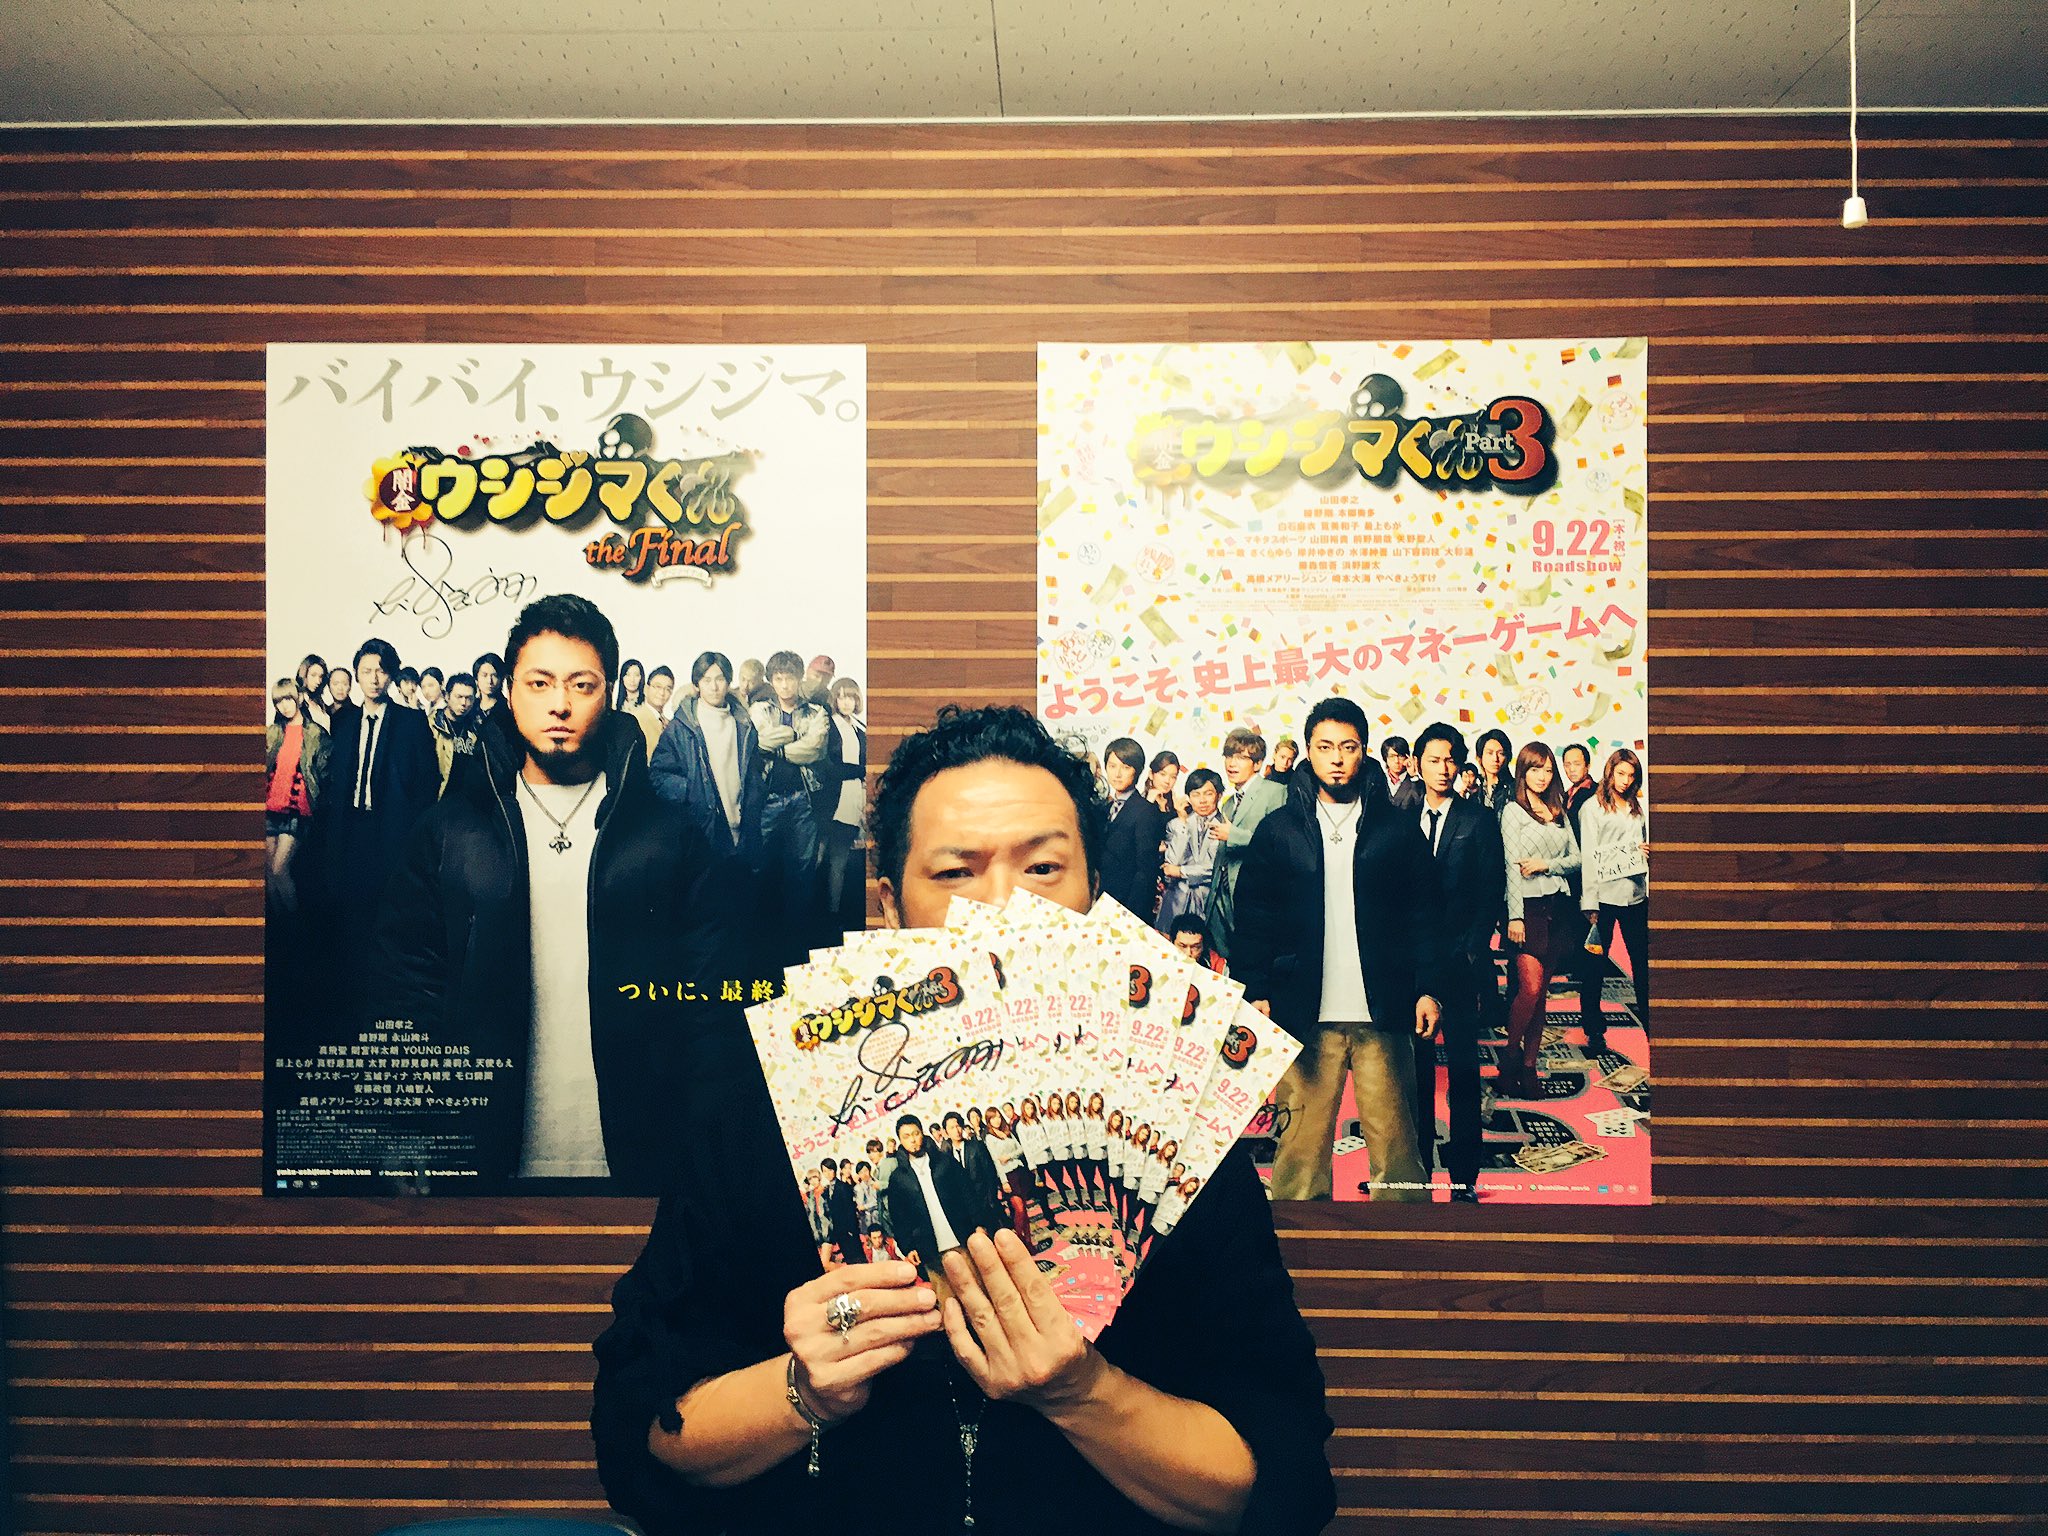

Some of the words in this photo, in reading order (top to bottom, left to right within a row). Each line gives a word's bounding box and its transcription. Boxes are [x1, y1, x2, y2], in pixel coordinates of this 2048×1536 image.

[280, 355, 860, 423] バイバイ、ウシジマ。
[1465, 432, 1515, 452] Part
[1487, 398, 1546, 481] 3
[586, 535, 626, 565] the
[623, 521, 742, 577] Final
[1533, 519, 1611, 557] 9.22
[1532, 560, 1622, 573] Roadshow
[1044, 603, 1638, 720] ようこそ、史上最大のマネーゲームへ
[618, 979, 788, 1001] ついに、最終
[375, 1020, 414, 1030] 山田孝之
[961, 1007, 994, 1030] 9.22
[1132, 1020, 1164, 1042] 9.22
[403, 1046, 442, 1055] YOUNG
[444, 1046, 470, 1055] DAIS
[1173, 1037, 1206, 1062] 9.22
[1217, 1079, 1249, 1108] 9.22
